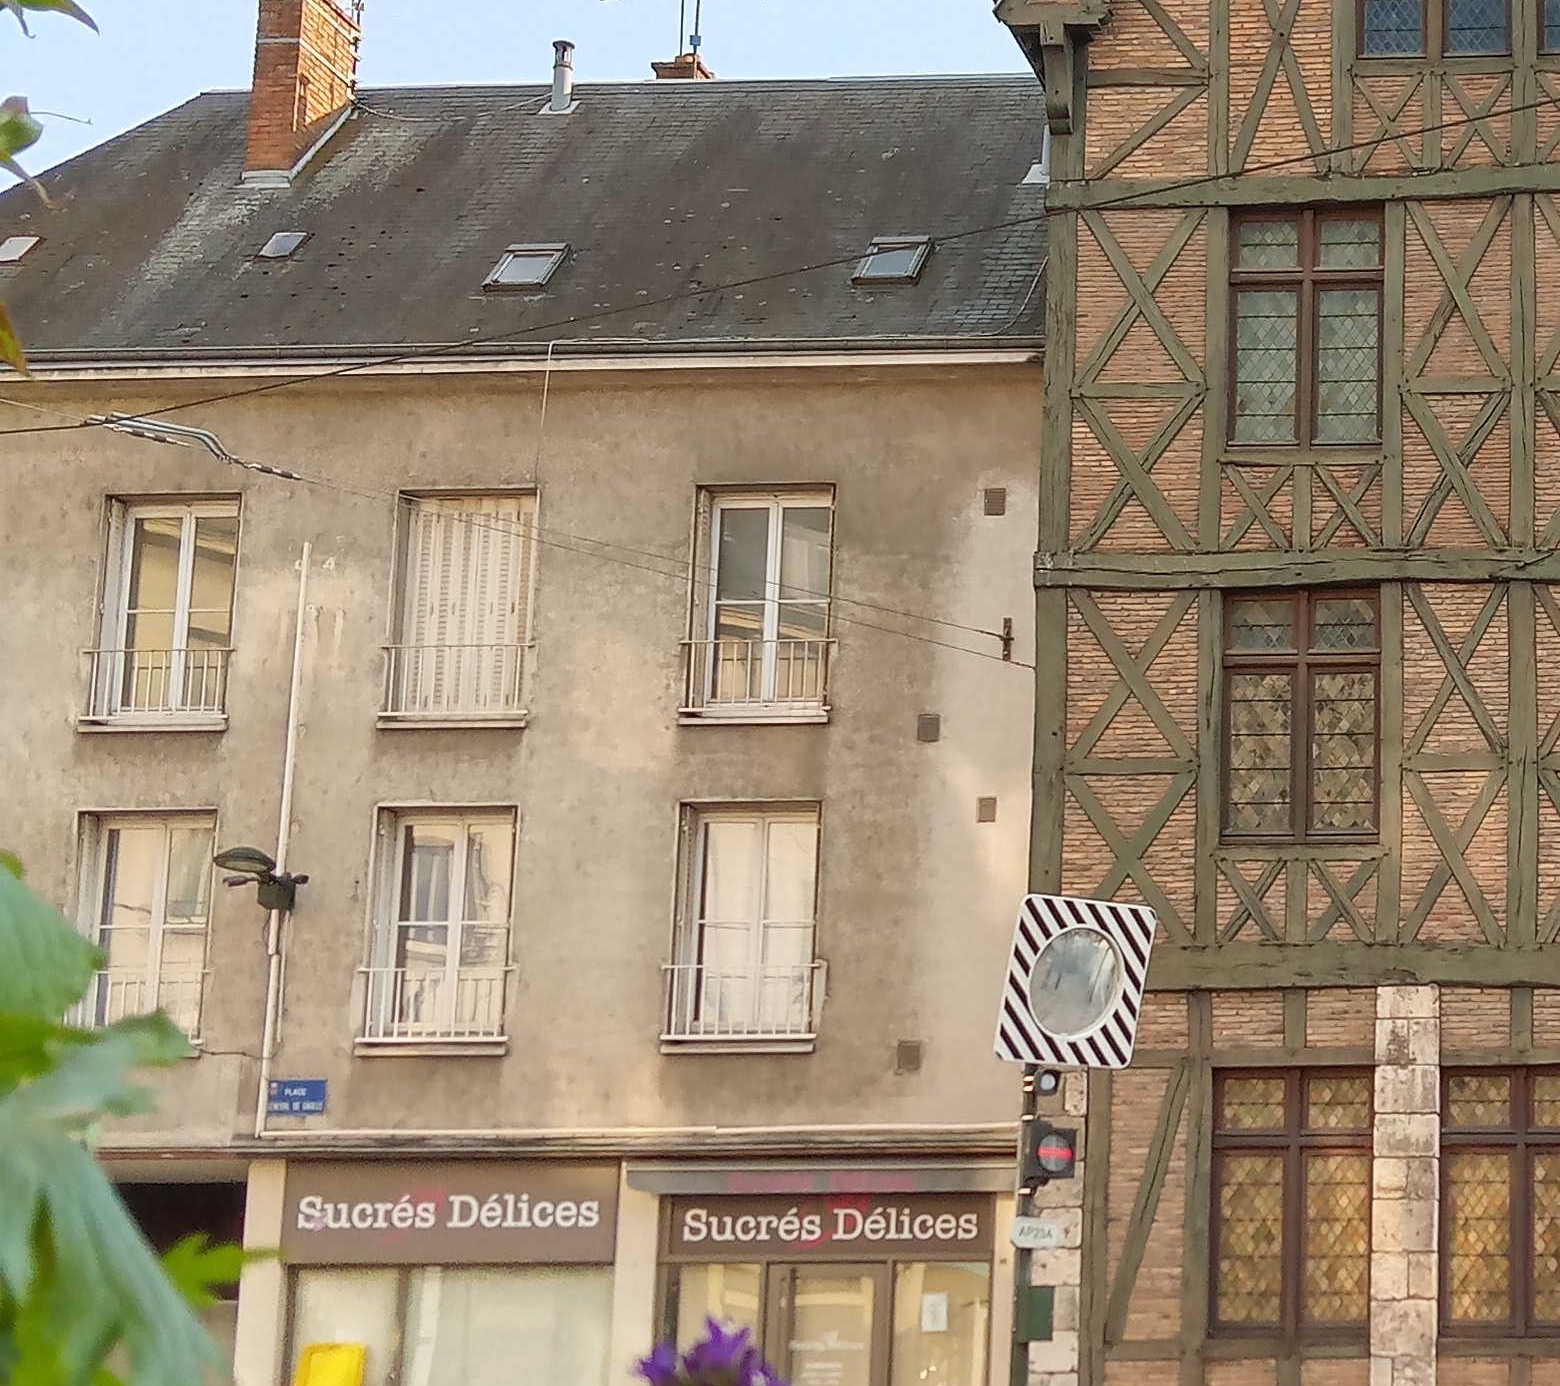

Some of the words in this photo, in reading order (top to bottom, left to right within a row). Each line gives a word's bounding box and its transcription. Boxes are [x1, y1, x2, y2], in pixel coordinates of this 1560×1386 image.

[297, 1194, 437, 1231] Sucrés
[446, 1192, 600, 1230] Délices
[682, 1206, 822, 1242] Sucrés
[831, 1204, 979, 1241] Délices
